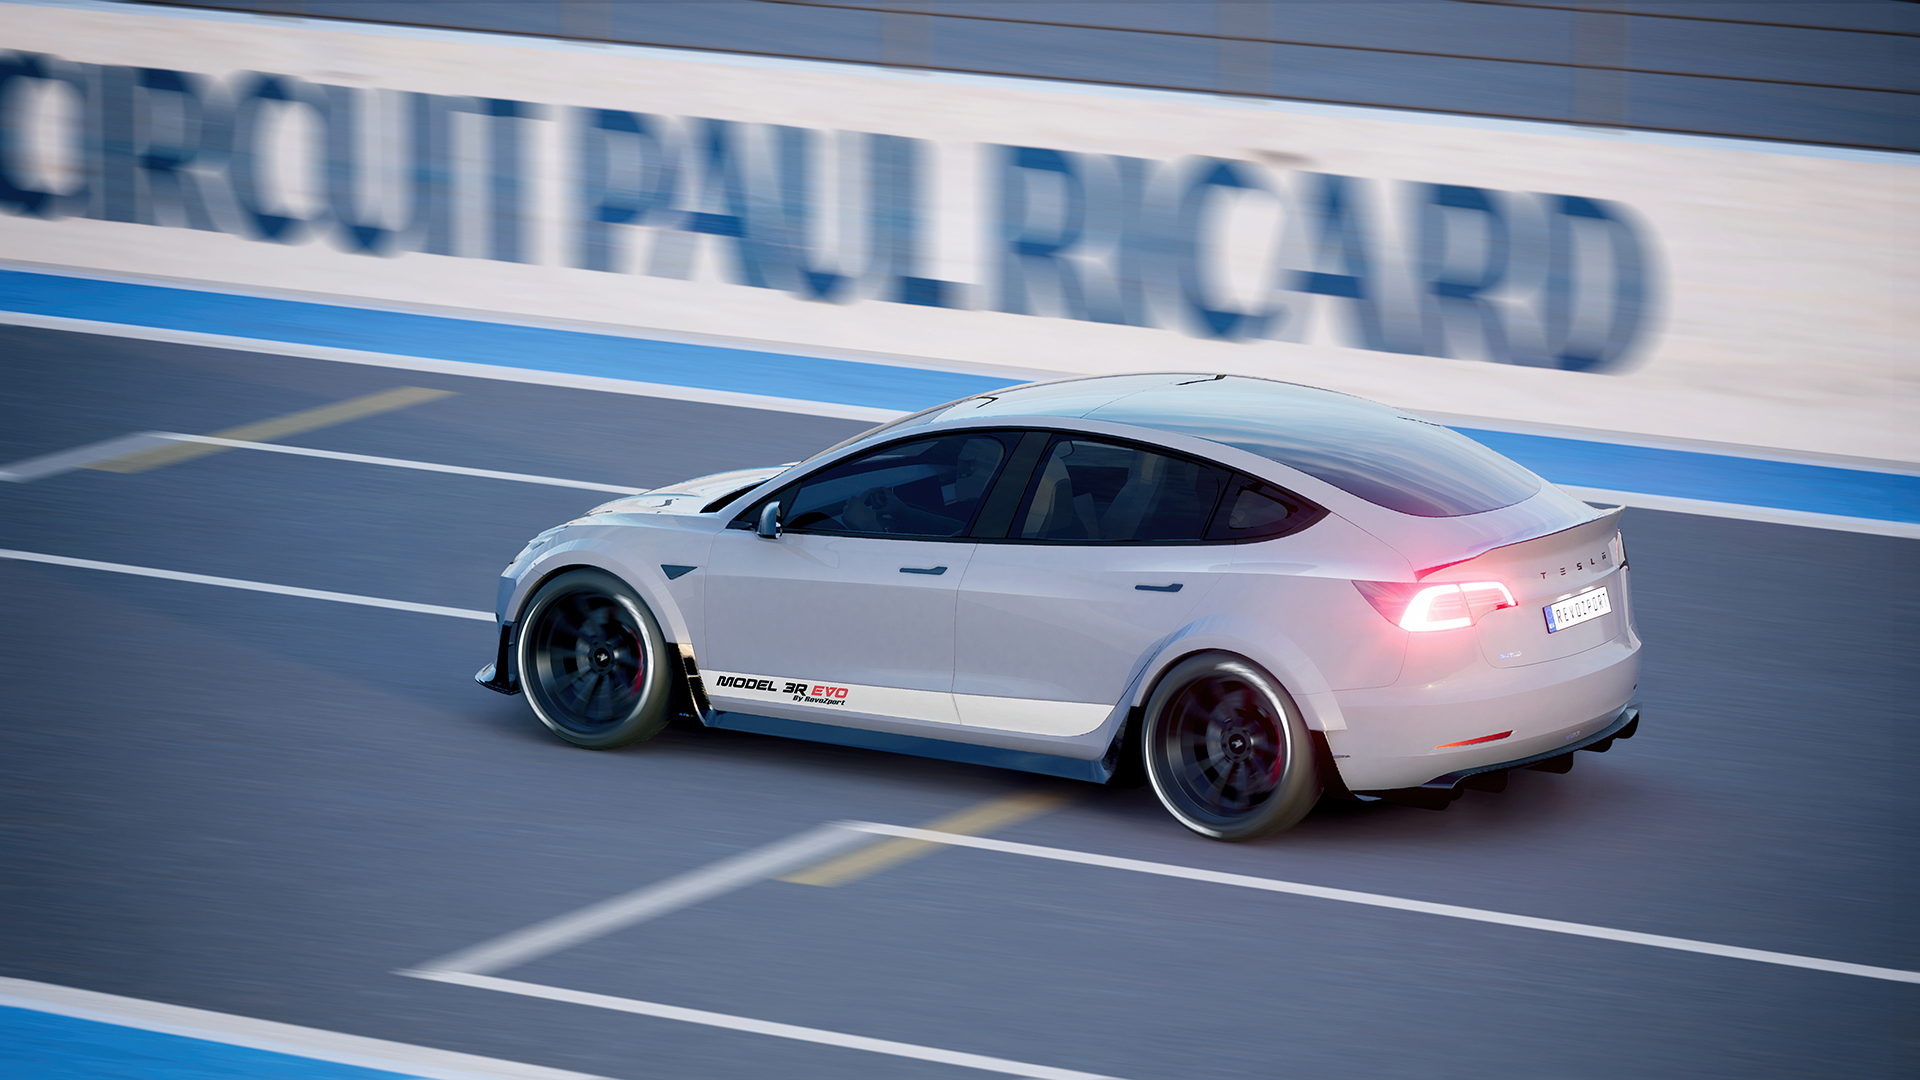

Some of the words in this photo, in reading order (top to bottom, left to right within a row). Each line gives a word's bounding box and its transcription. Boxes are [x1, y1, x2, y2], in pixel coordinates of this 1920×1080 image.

[0, 48, 560, 267] CIRCUIT
[575, 105, 985, 311] PAUL
[980, 143, 1672, 376] RICARD
[1540, 551, 1607, 579] TESLA
[1556, 593, 1607, 624] REVOZPORT
[716, 675, 777, 692] MODEL
[782, 682, 808, 697] 3R
[811, 685, 849, 699] EVO
